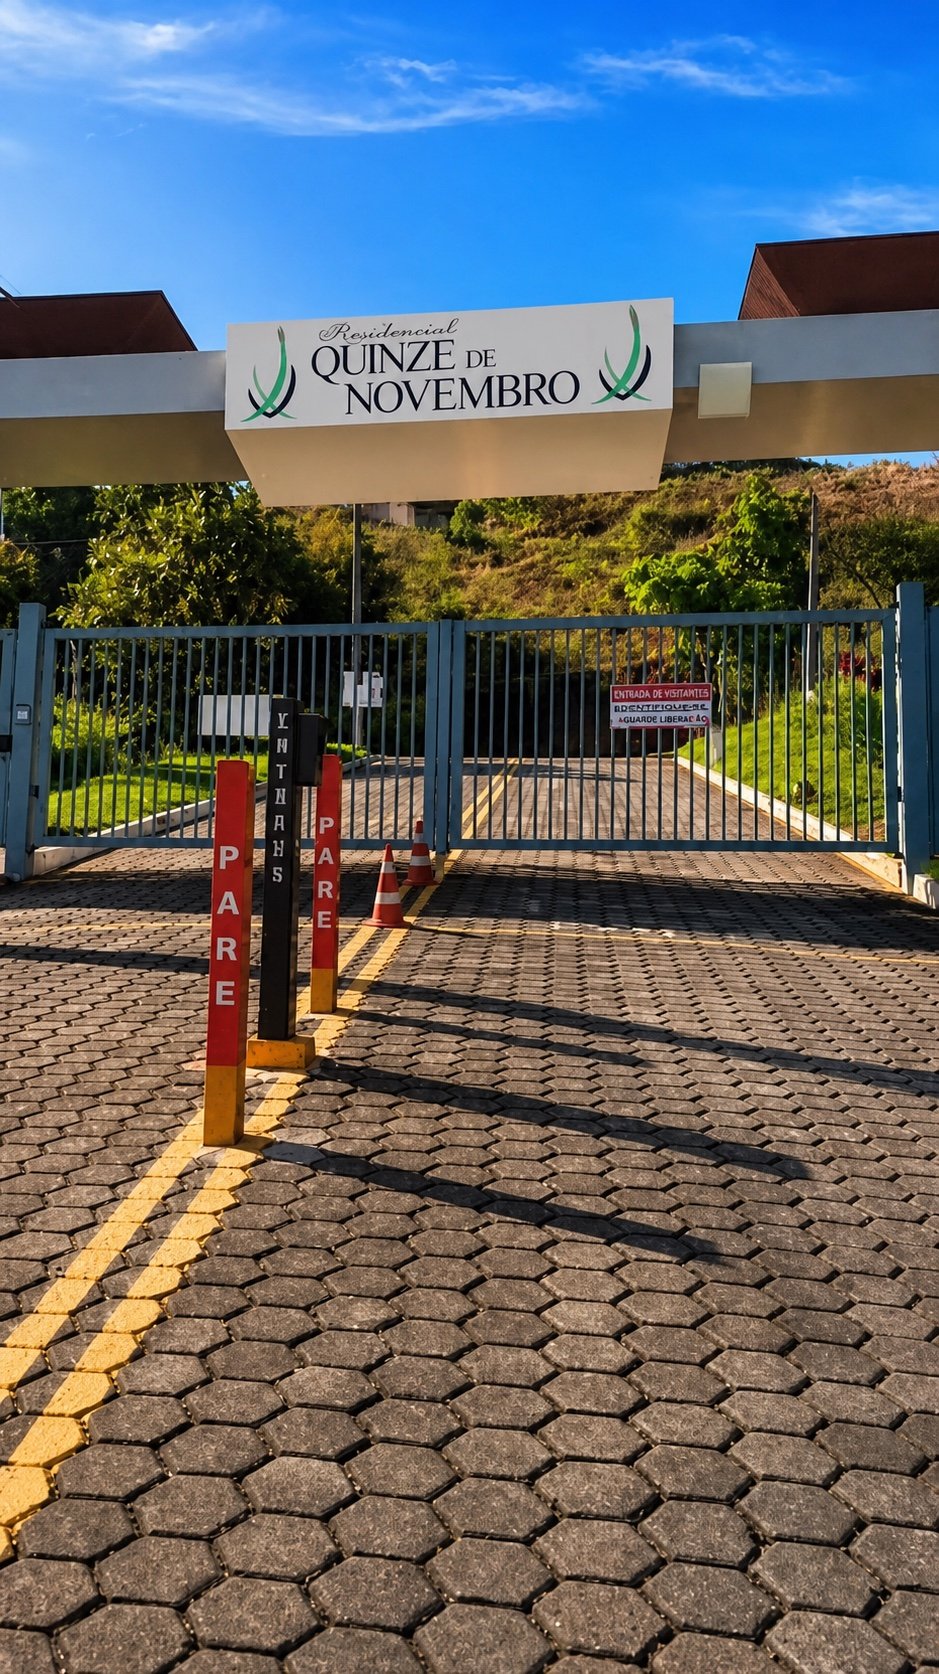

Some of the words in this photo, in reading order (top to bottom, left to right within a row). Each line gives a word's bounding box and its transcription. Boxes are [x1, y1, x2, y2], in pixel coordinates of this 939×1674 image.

[318, 318, 459, 344] Residencial
[311, 339, 455, 385] QUINZE
[465, 348, 496, 369] DE
[345, 370, 580, 415] NOVEMBRO
[613, 689, 651, 699] ENTRADA
[653, 689, 663, 698] DE
[664, 688, 709, 698] VISITANTES
[316, 816, 335, 929] PARE
[215, 845, 240, 1007] PARE
